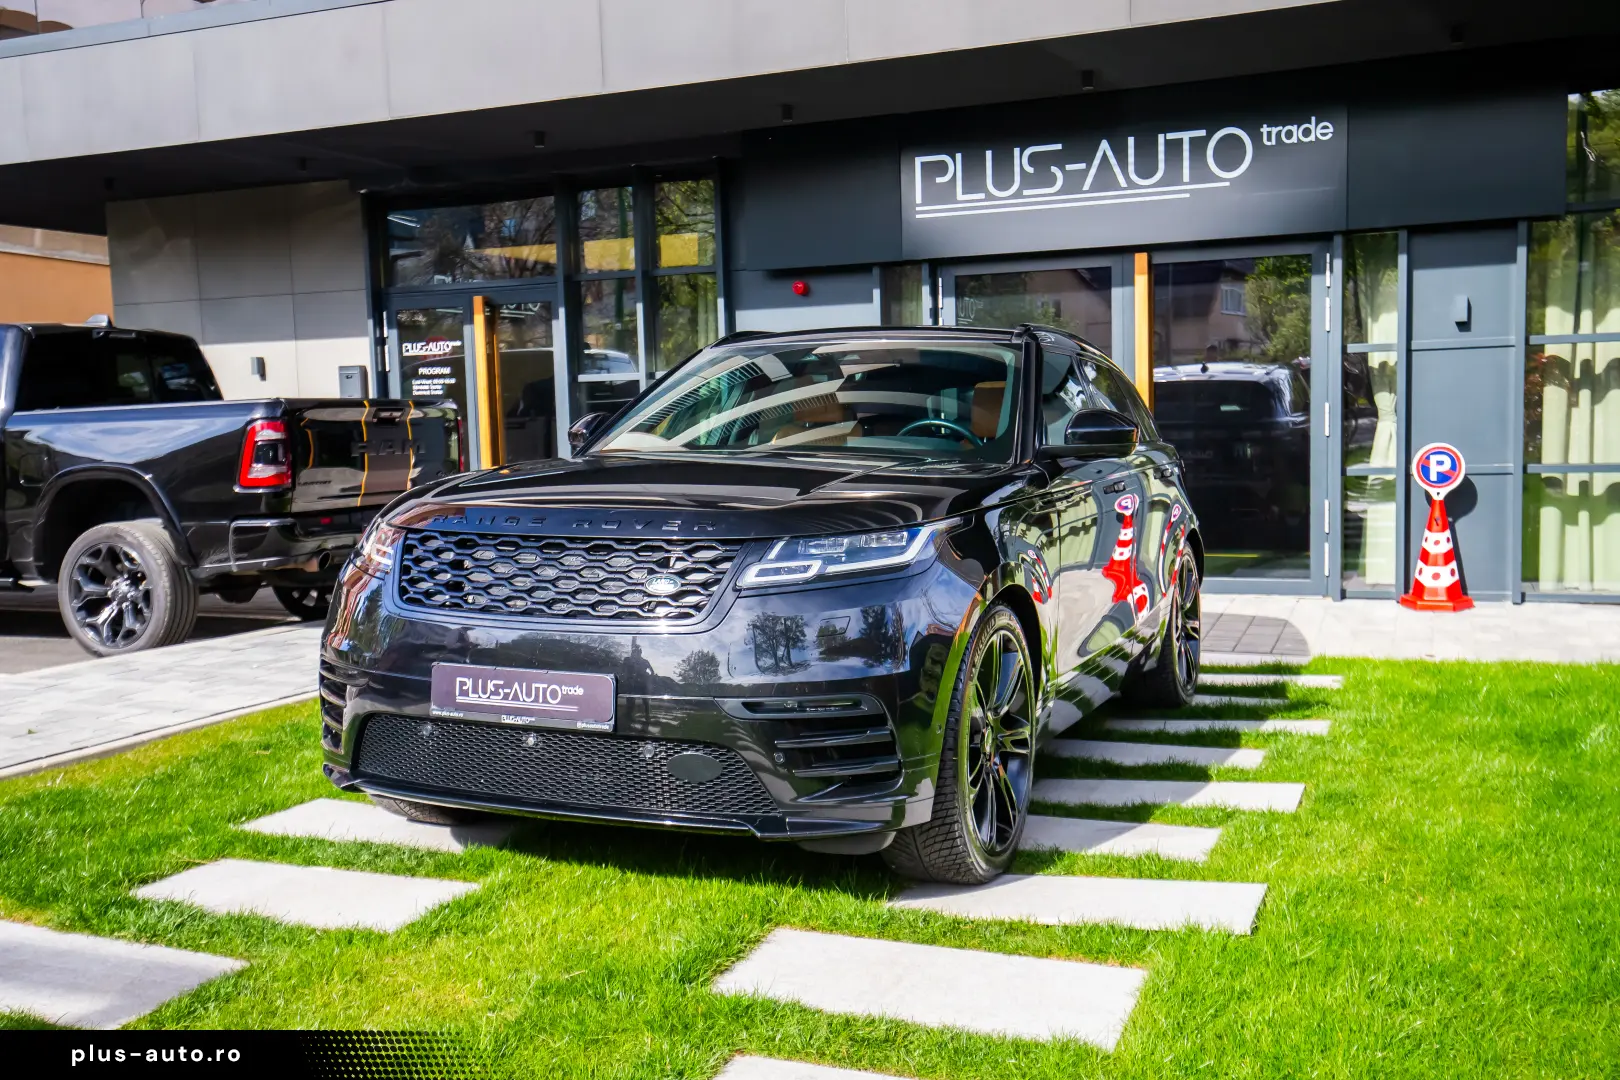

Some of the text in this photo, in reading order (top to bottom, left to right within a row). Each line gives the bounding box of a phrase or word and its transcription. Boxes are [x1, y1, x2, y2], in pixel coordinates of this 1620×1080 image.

[914, 116, 1334, 204] PLUS-AUTO trade
[418, 366, 451, 375] PROGRAM
[351, 439, 426, 457] RAM
[1429, 454, 1451, 481] P
[432, 514, 716, 532] RANGE ROVER
[455, 676, 584, 704] PLUS-AUTO trade
